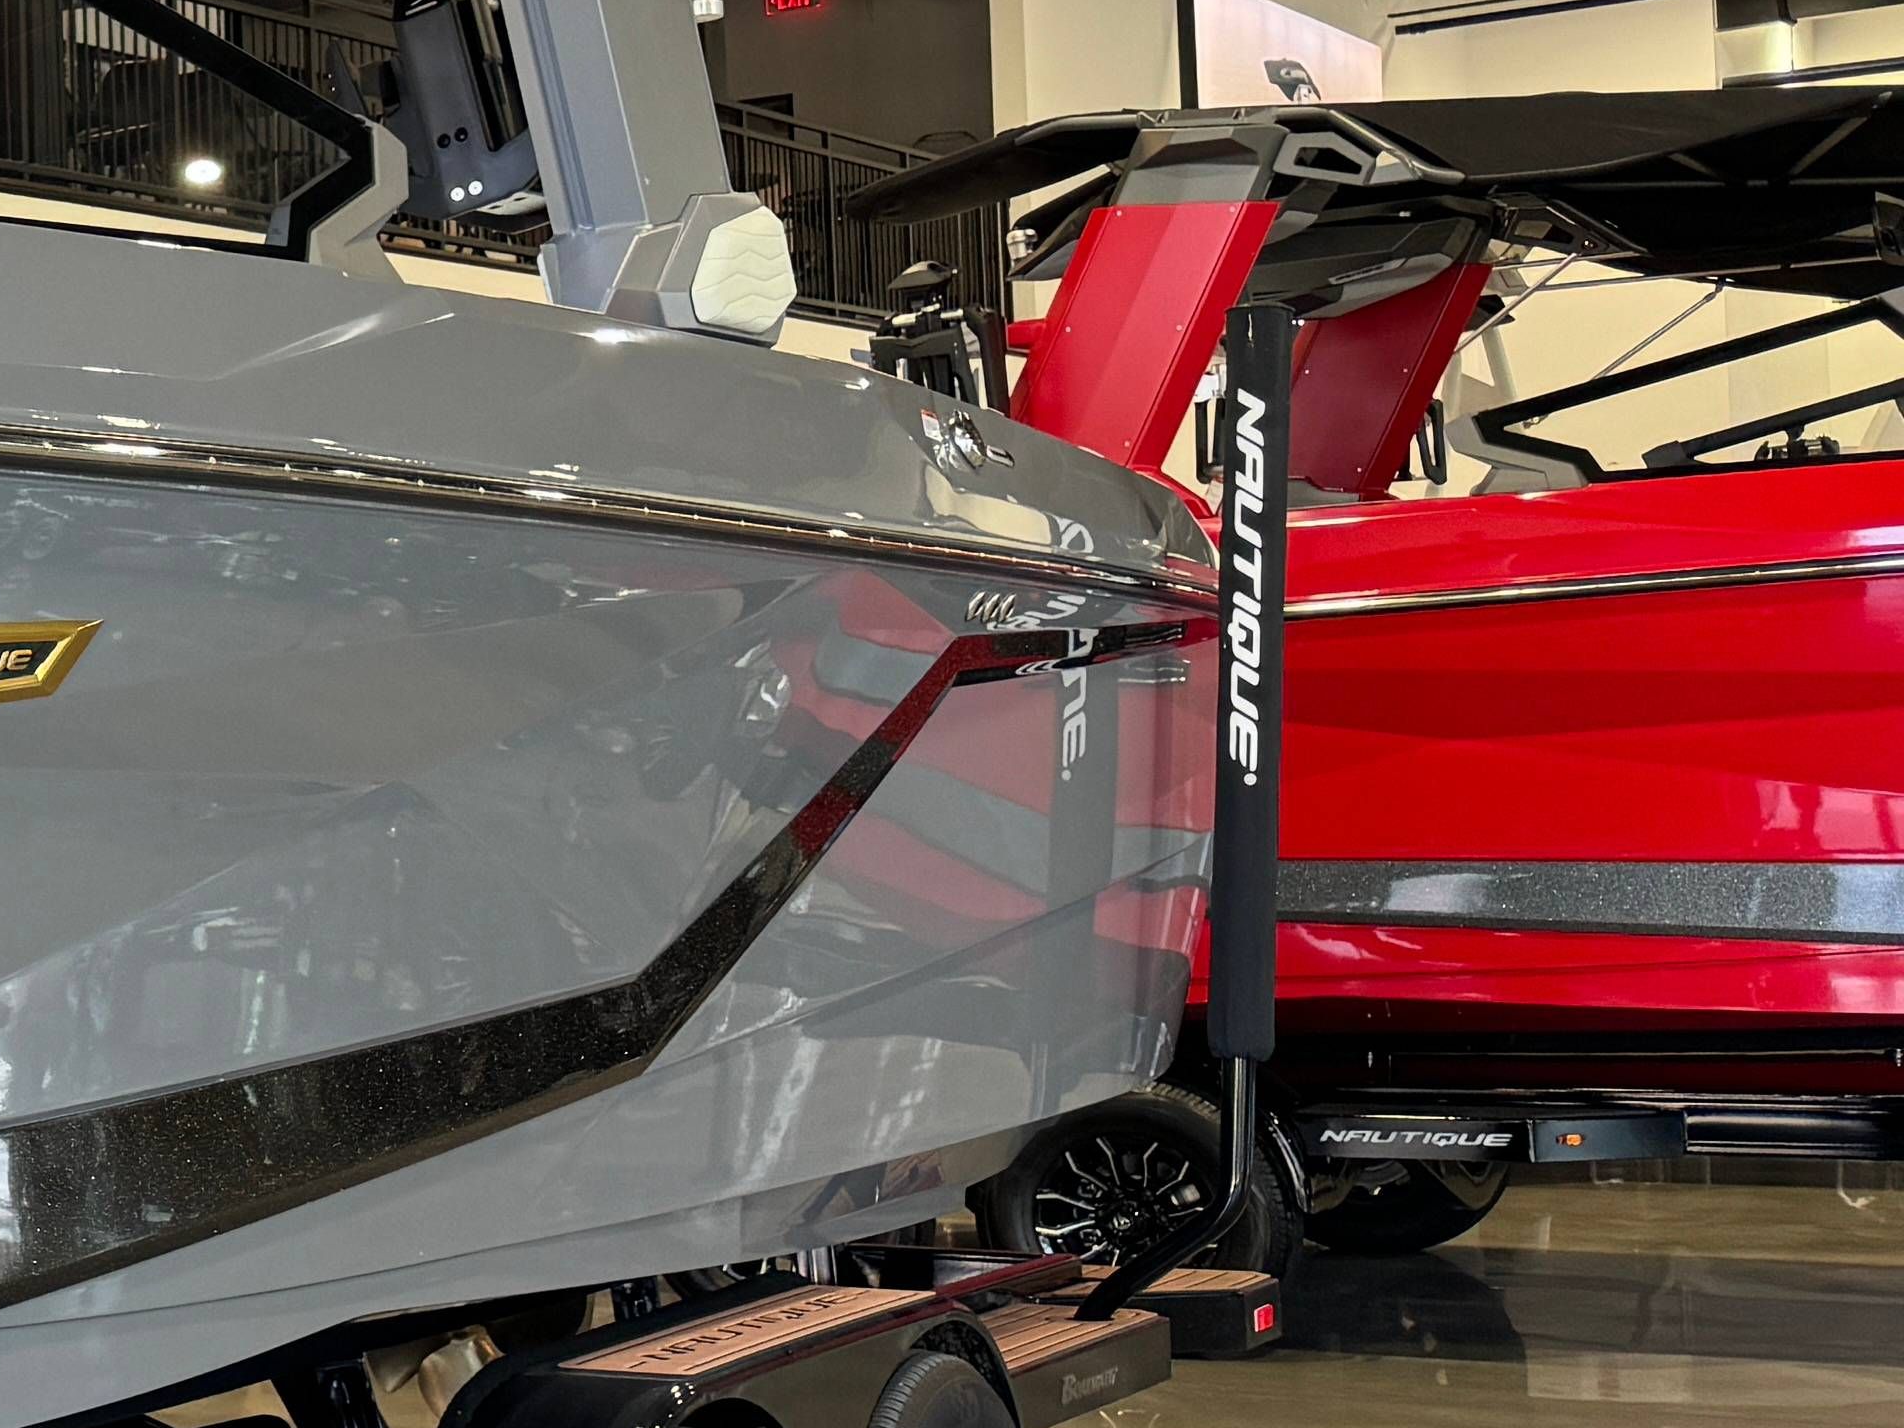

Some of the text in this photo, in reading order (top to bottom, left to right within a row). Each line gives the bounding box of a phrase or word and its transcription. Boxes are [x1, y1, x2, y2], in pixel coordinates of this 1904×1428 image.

[1228, 388, 1266, 774] NAUTIQUE
[1319, 1128, 1513, 1147] NAUTIQUE
[644, 1293, 848, 1362] NAUTIQUE
